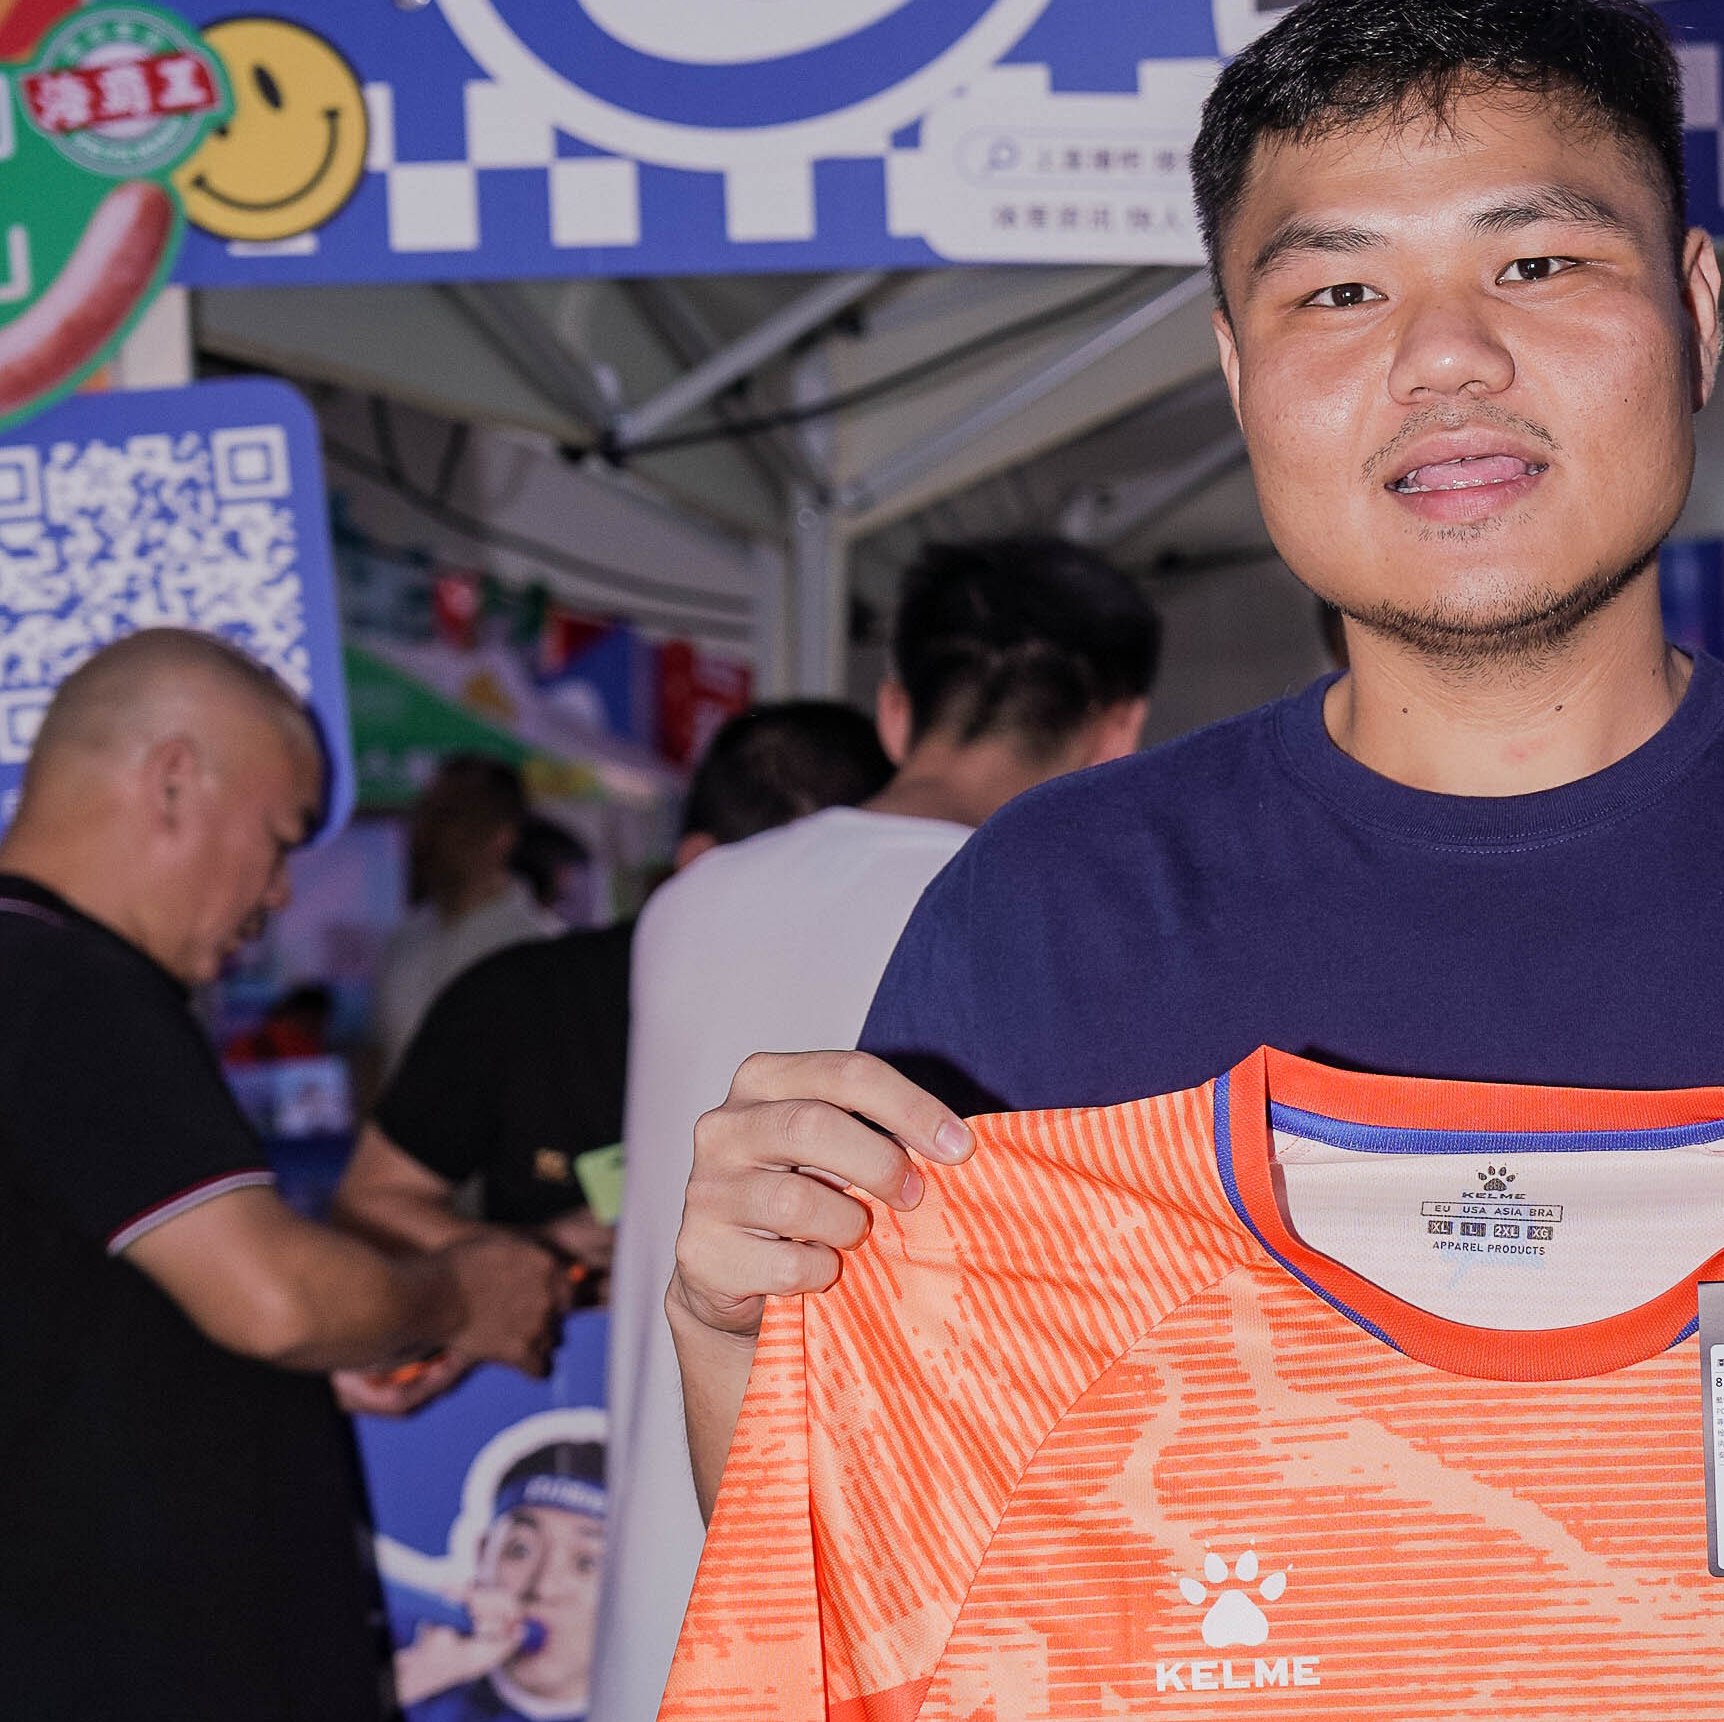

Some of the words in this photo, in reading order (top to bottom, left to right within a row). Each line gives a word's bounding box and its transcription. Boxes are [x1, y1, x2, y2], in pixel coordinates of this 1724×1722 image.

[1462, 1192, 1526, 1200] KELME
[1434, 1204, 1451, 1213] EU
[1462, 1206, 1487, 1215] USA
[1494, 1207, 1522, 1216] ASIA
[1529, 1208, 1554, 1217] BRA
[1432, 1222, 1450, 1233] XL
[1495, 1225, 1519, 1237] 2XL
[1532, 1227, 1550, 1238] XG
[1432, 1241, 1484, 1253] APPAREL
[1487, 1244, 1547, 1256] PRODUCTS
[1155, 1656, 1321, 1693] KELME
